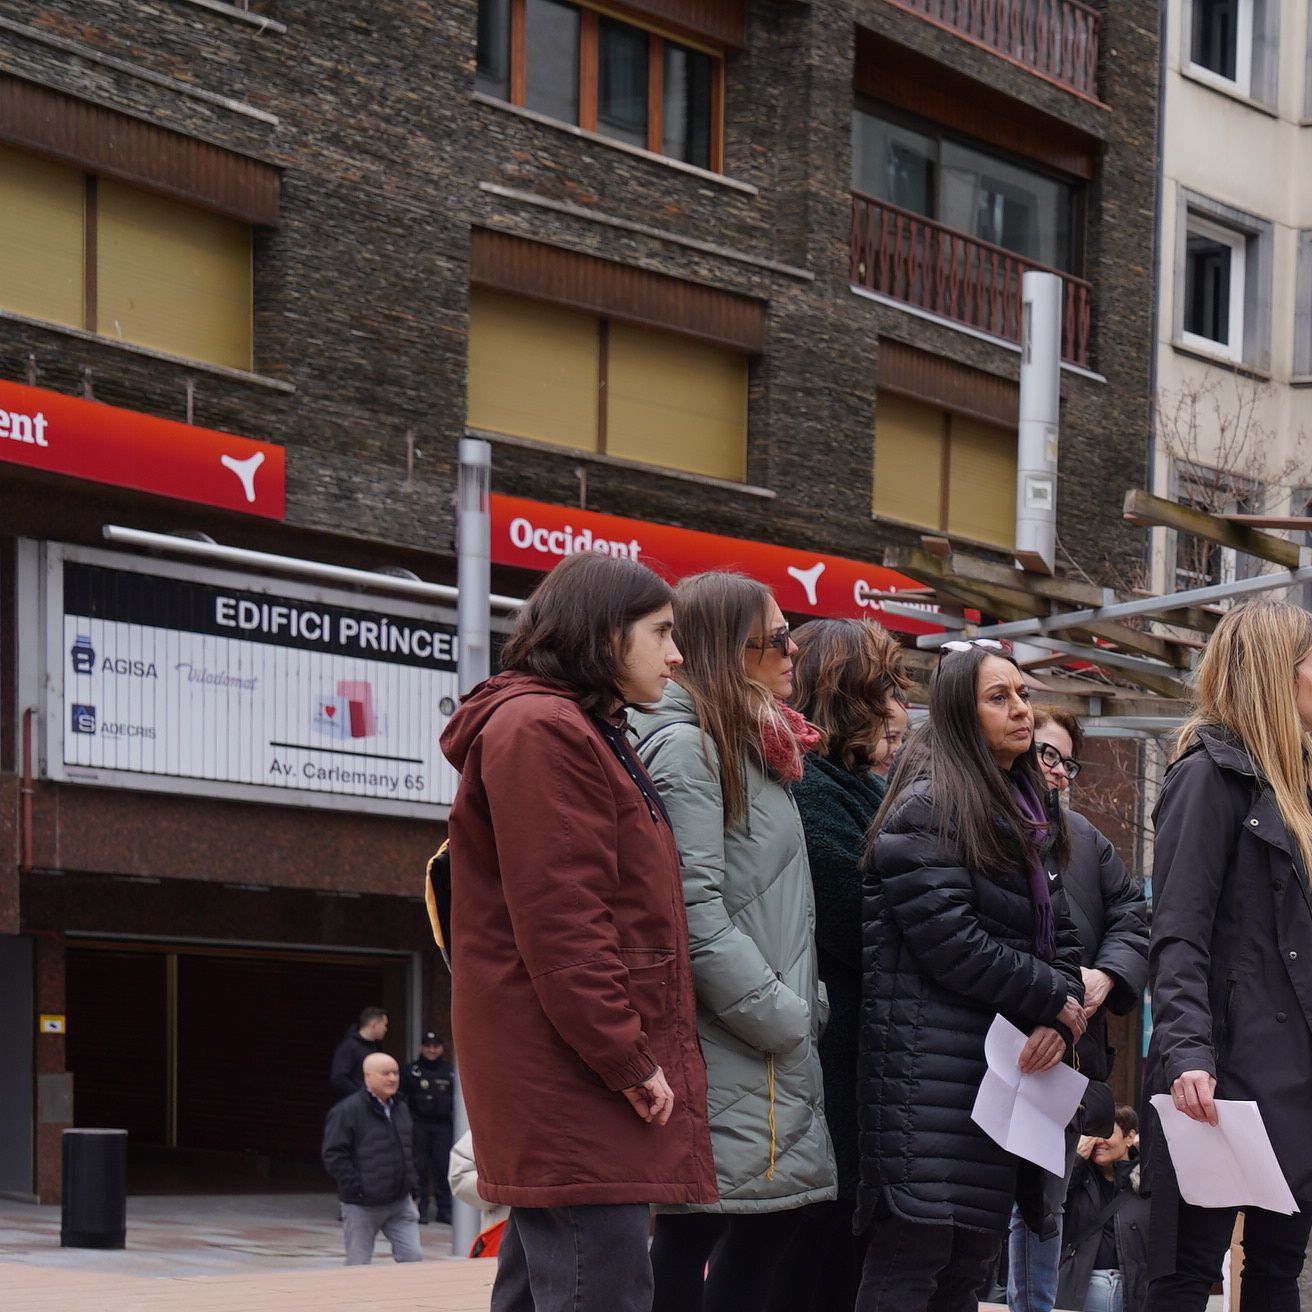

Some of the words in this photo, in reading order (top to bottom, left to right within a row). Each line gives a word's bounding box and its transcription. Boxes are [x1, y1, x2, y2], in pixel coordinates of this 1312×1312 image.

[215, 597, 331, 642] EDIFICI
[339, 617, 458, 663] PRÍNCE
[102, 657, 158, 679] AGISA
[269, 759, 296, 777] Av.
[303, 764, 399, 792] Carlemany
[403, 775, 425, 791] 65
